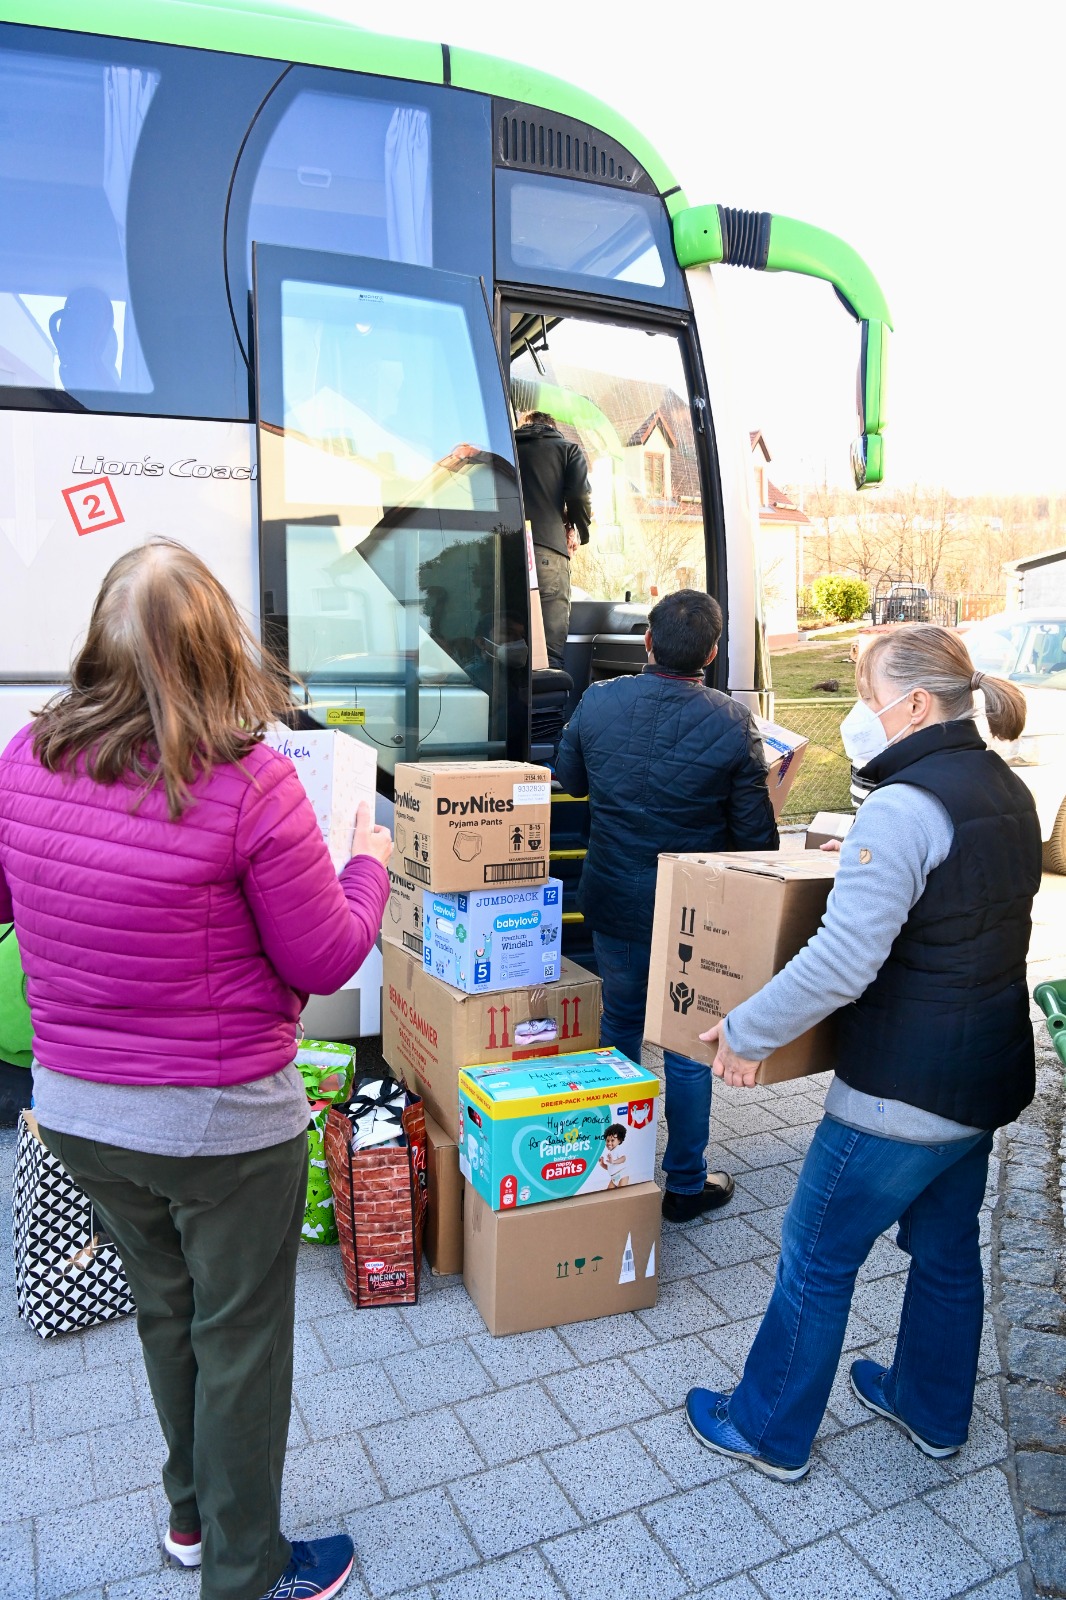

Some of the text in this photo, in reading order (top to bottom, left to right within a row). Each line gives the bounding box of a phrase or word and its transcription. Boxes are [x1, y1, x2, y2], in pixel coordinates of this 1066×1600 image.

[72, 455, 164, 477] Lion's
[82, 494, 105, 520] 2
[437, 793, 515, 816] DryNites
[448, 818, 503, 829] Pyjama Pants
[476, 891, 539, 908] JUMBOPACK
[545, 890, 557, 899] 72
[433, 904, 455, 919] babylove
[496, 916, 539, 928] babylove
[501, 934, 527, 942] Premium
[501, 940, 534, 951] Windeln
[425, 948, 431, 961] 5
[477, 963, 488, 978] 5
[540, 1097, 581, 1108] DREIER-PACK
[602, 1092, 618, 1100] PACK
[528, 1137, 540, 1151] for
[540, 1140, 591, 1159] Pampers
[545, 1163, 583, 1180] pants
[504, 1178, 513, 1189] 6
[369, 1272, 406, 1282] AMERICAN
